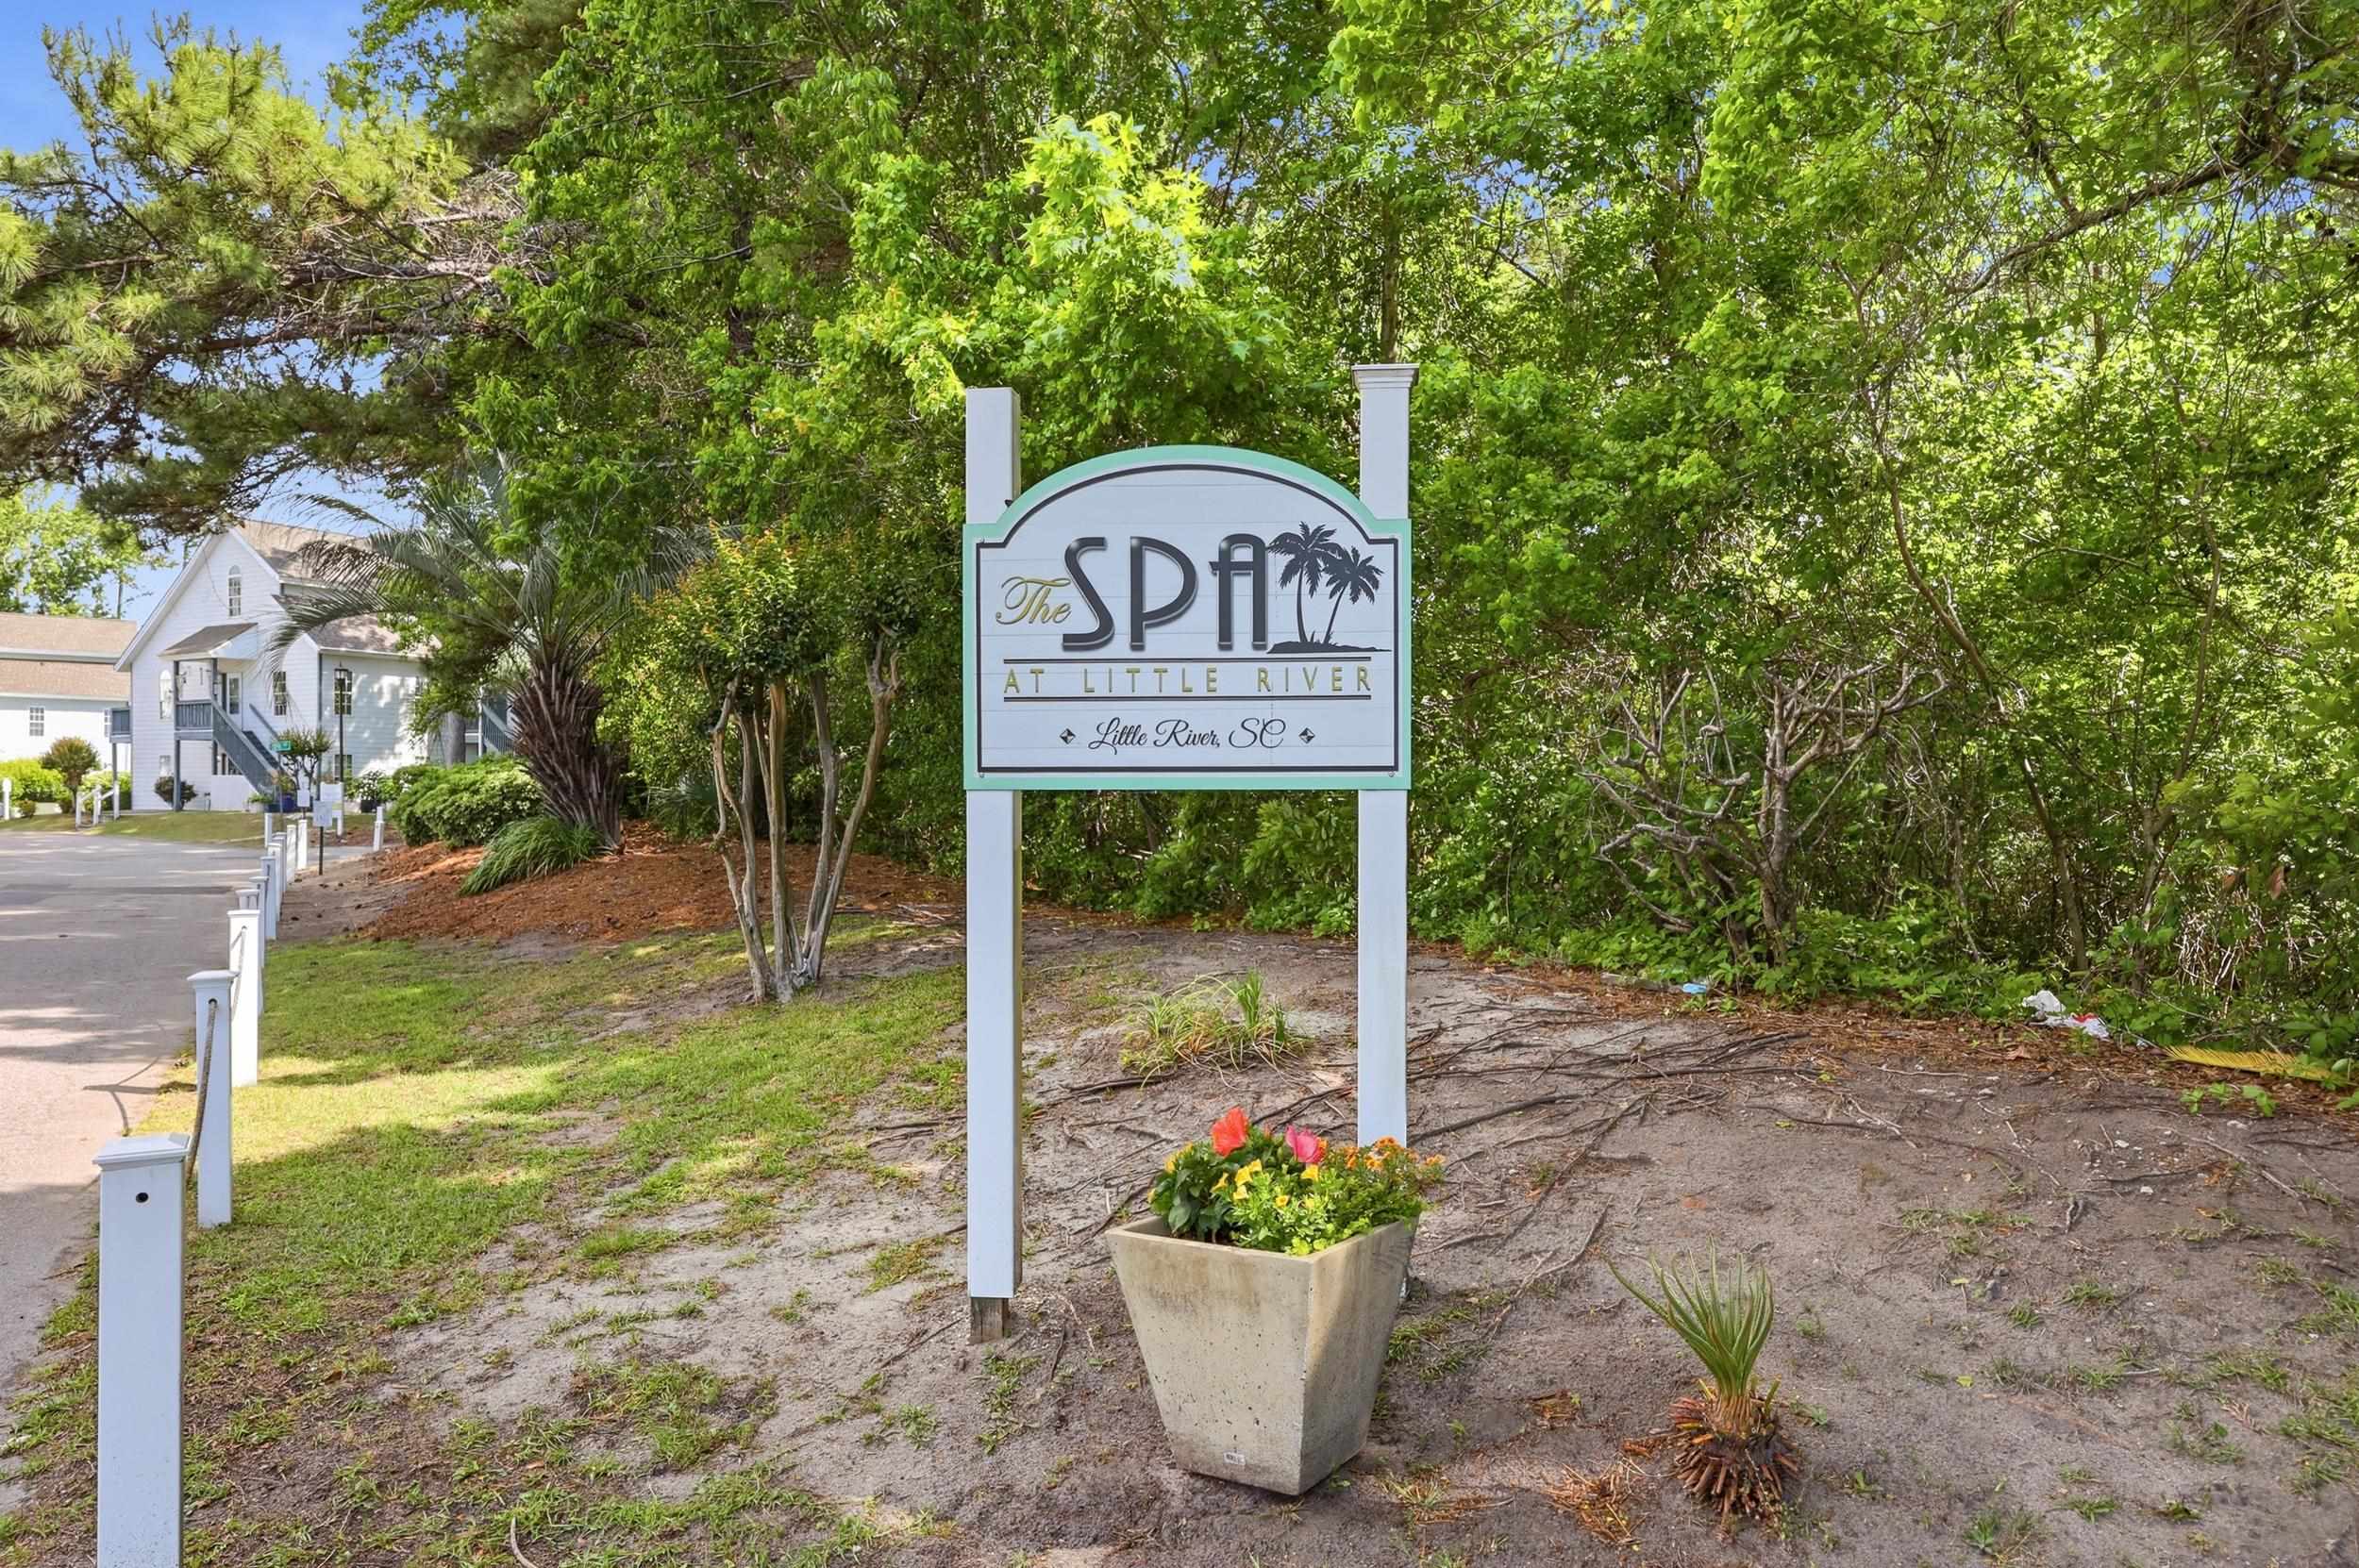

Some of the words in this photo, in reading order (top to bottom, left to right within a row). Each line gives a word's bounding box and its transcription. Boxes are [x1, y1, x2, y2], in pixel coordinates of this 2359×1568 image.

[995, 576, 1072, 625] The
[1062, 533, 1269, 652] SPA
[1003, 667, 1045, 694] AT
[1083, 666, 1219, 694] LITTLE
[1257, 665, 1372, 692] RIVER
[1088, 717, 1148, 755] Little
[1153, 719, 1221, 748] River,
[1229, 717, 1286, 748] SC
